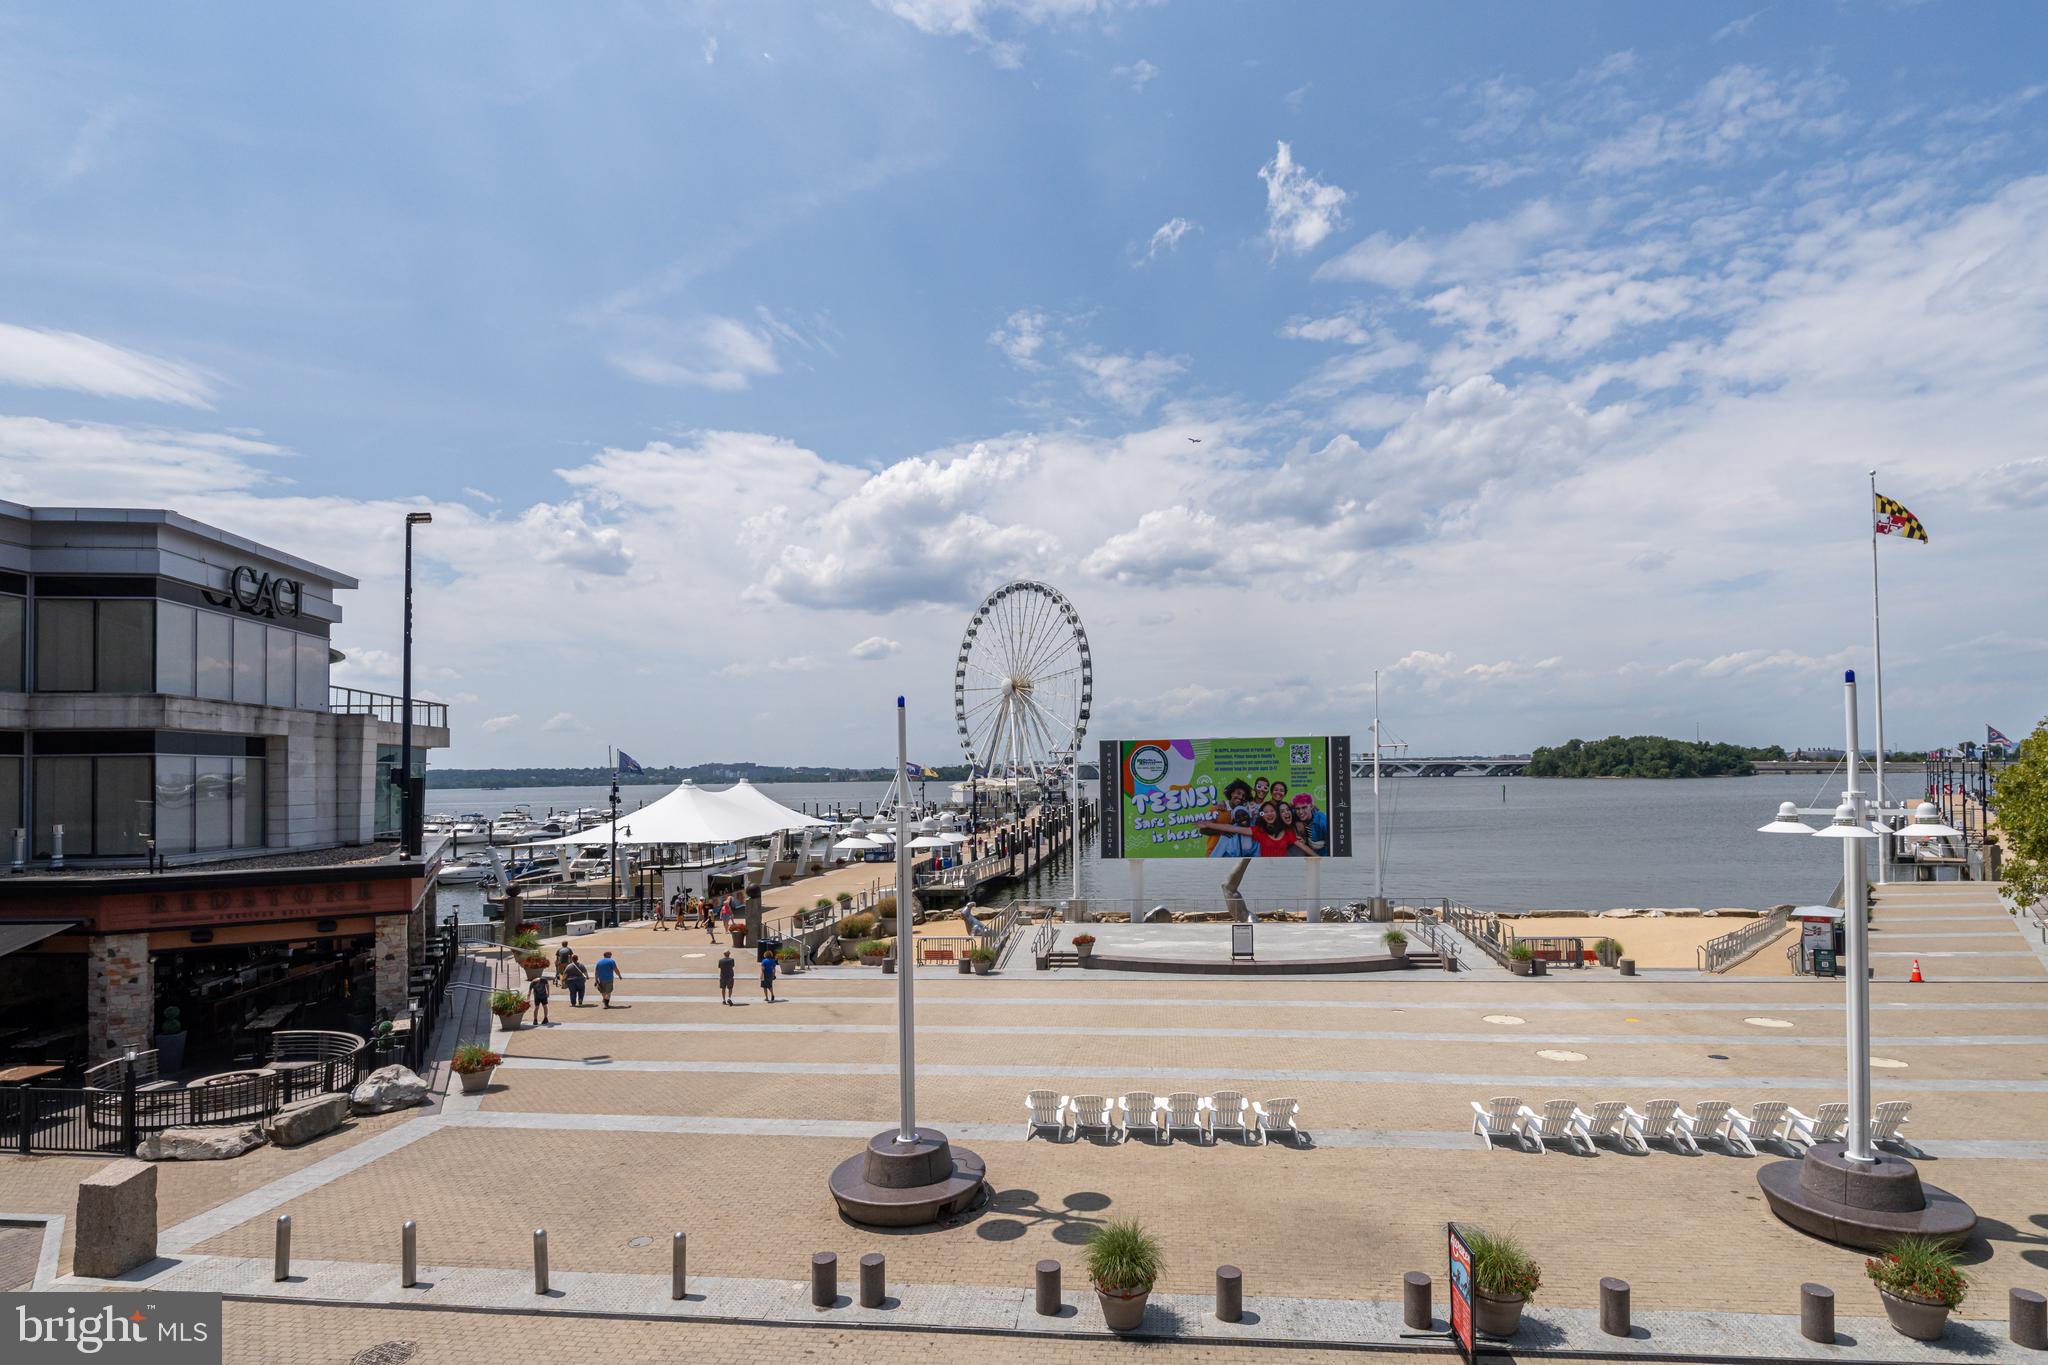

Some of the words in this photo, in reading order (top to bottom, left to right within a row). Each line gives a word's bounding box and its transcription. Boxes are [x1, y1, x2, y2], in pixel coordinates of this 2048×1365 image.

[232, 566, 305, 618] CACI
[1131, 785, 1217, 815] TEENS!
[1134, 817, 1166, 830] Safe
[1167, 811, 1219, 826] Summer
[1152, 830, 1164, 843] is
[147, 883, 372, 914] REDSTONE
